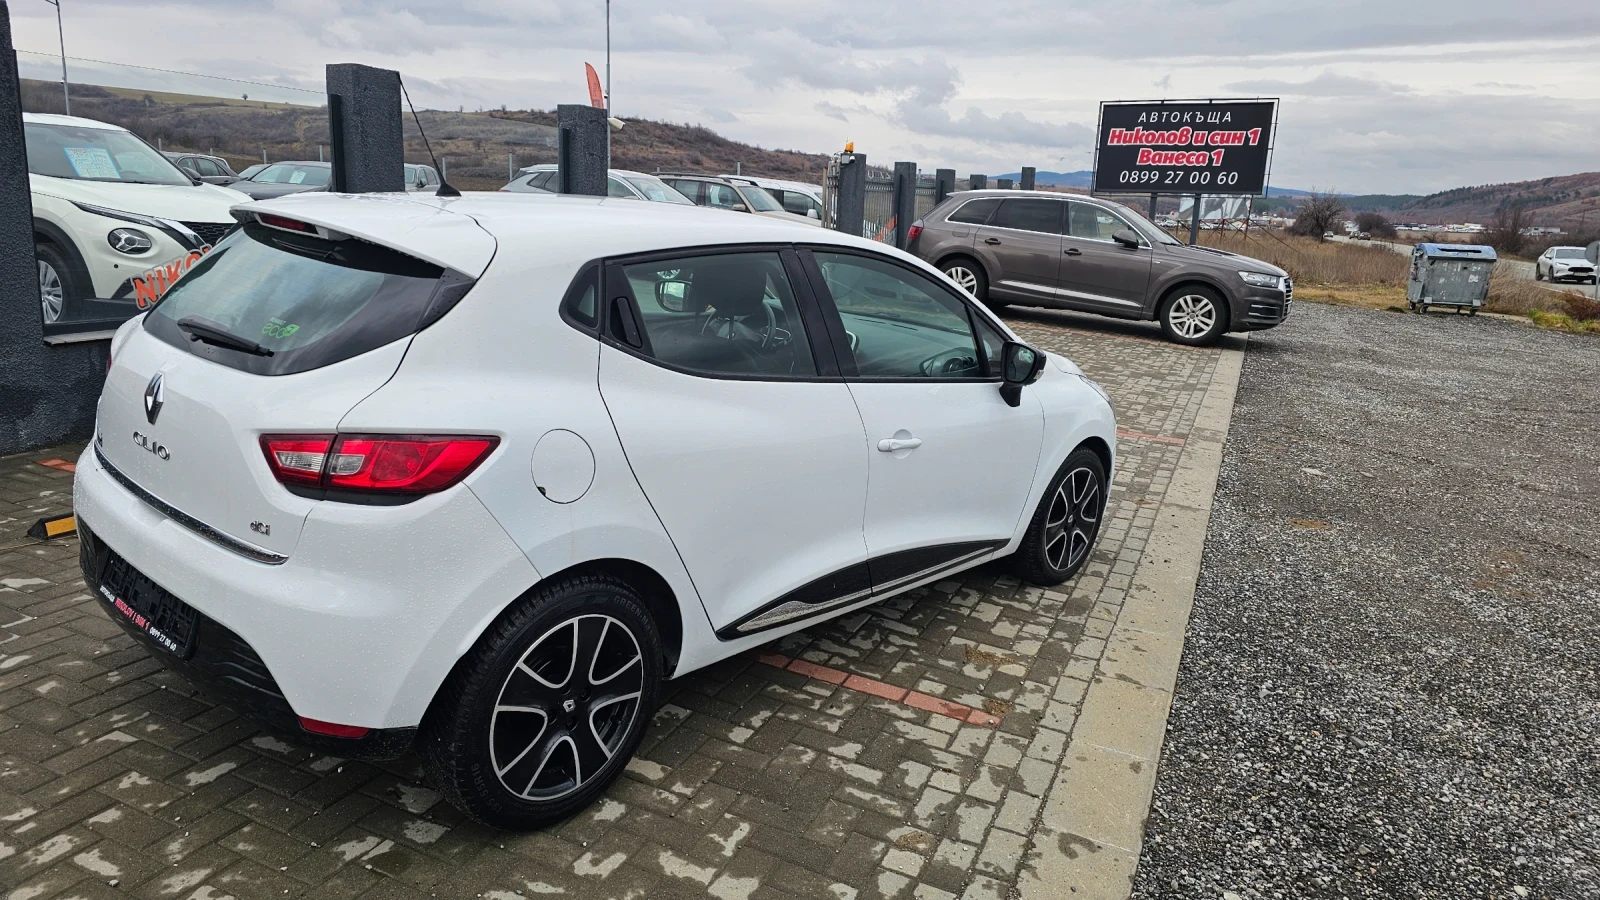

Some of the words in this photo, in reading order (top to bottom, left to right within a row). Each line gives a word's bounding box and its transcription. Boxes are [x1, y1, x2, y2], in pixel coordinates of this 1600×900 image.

[1138, 111, 1232, 124] АВТОКЪЩА
[1108, 126, 1192, 146] Николов
[1192, 131, 1207, 146] и
[1208, 130, 1246, 146] син
[1247, 127, 1262, 146] 1
[1137, 148, 1209, 166] Ванеса
[1212, 149, 1225, 166] 1
[1119, 170, 1160, 184] 0899
[1164, 171, 1184, 184] 27
[1189, 171, 1211, 185] 00
[1217, 171, 1238, 185] 60
[130, 244, 213, 310] NIKO
[132, 430, 171, 461] CLIO
